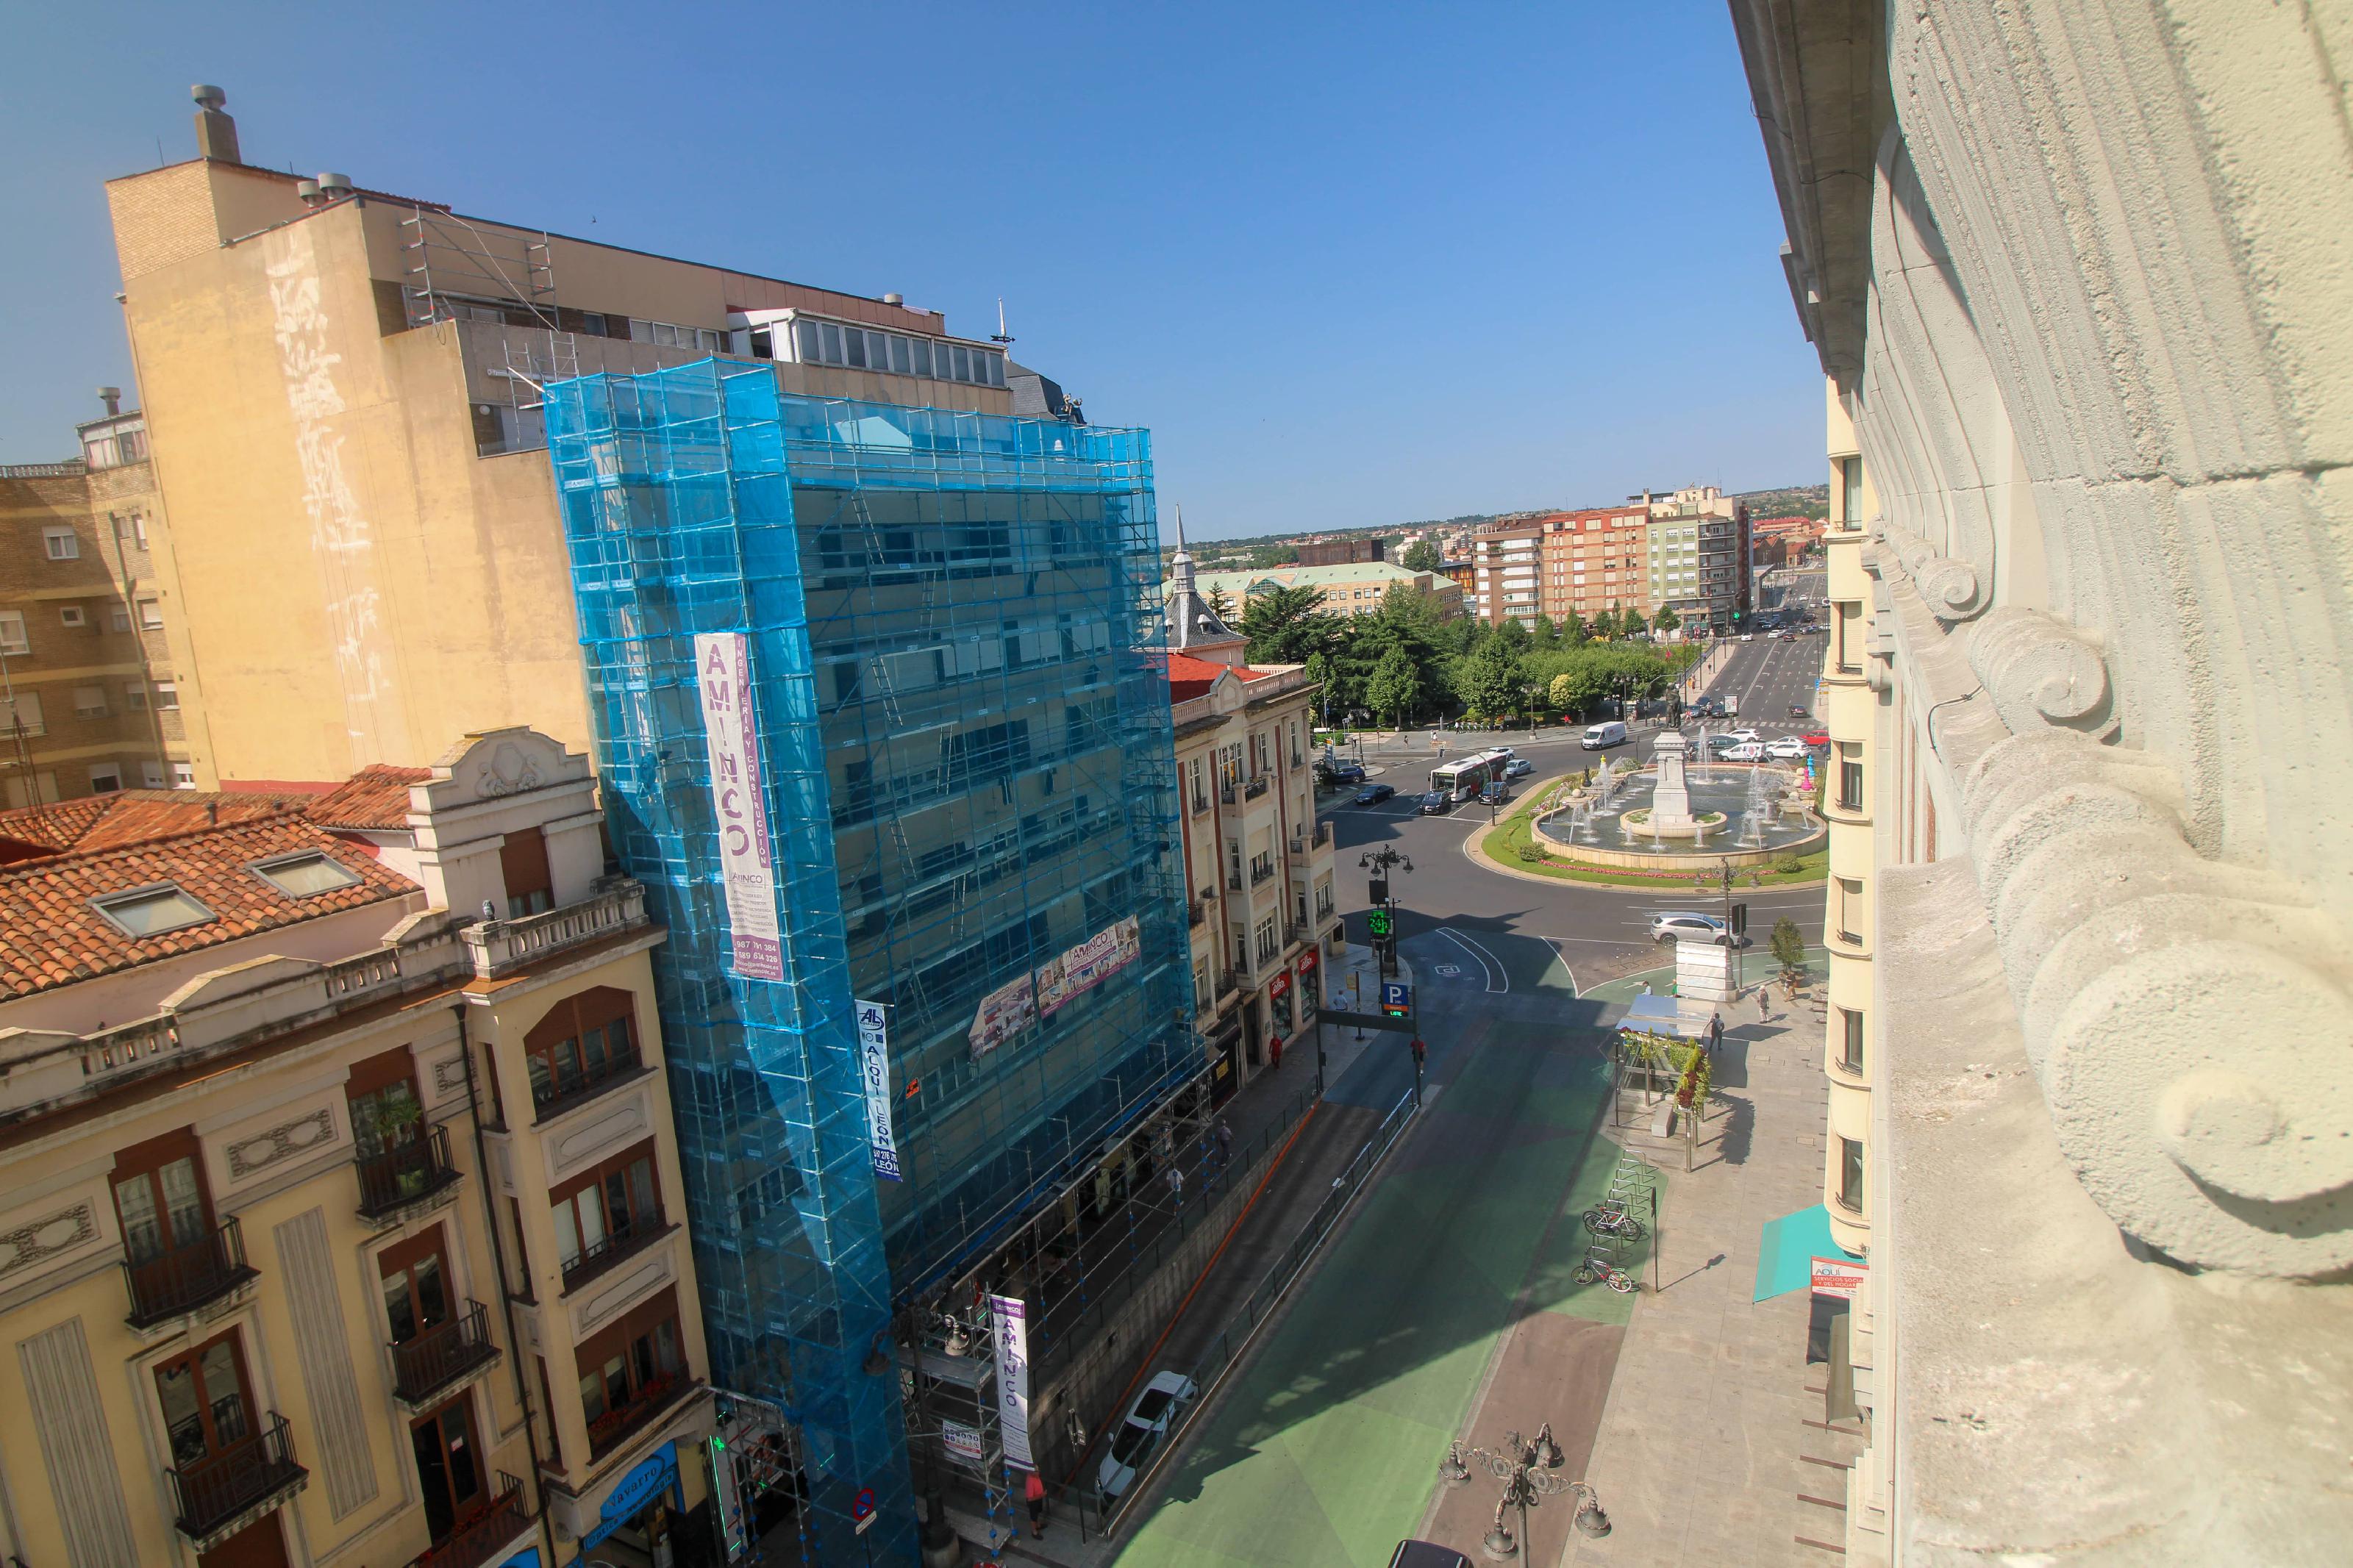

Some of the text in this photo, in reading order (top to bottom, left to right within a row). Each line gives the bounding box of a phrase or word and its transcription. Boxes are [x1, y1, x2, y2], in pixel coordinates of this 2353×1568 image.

[706, 643, 749, 856] AMINCO
[746, 740, 751, 748] Y
[1369, 918, 1388, 929] 24h
[764, 944, 776, 952] 384
[1074, 932, 1108, 959] AMINCO
[1389, 986, 1402, 1003] P
[860, 1008, 880, 1023] AL
[874, 1159, 899, 1172] LEÓN
[1815, 1266, 1841, 1275] AQUÍ
[1001, 1318, 1017, 1407] AMINCO
[607, 1467, 657, 1507] Navarro
